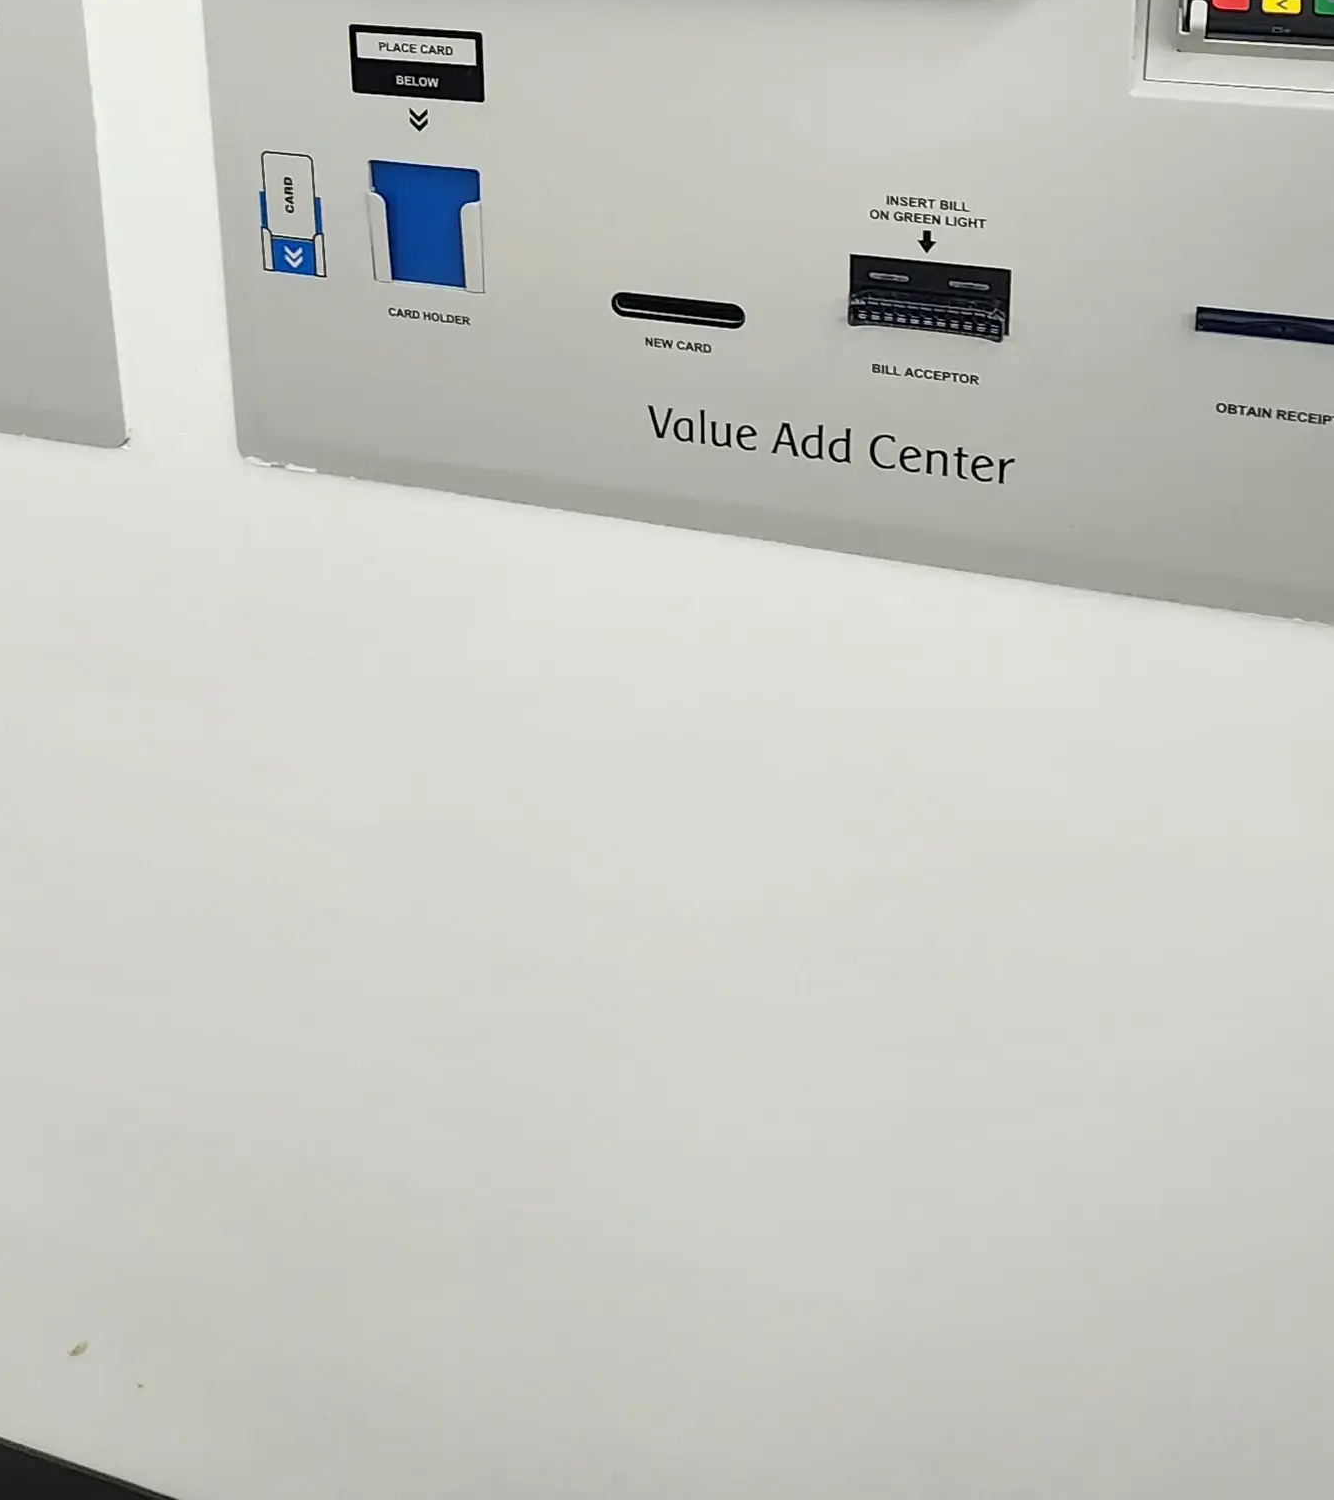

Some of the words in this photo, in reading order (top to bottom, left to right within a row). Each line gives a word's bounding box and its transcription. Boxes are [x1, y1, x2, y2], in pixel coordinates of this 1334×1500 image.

[378, 41, 417, 54] PLACE
[420, 44, 454, 56] CARD
[395, 75, 439, 88] BELOW
[284, 176, 295, 214] CARD
[885, 195, 936, 209] INSERT
[939, 198, 971, 213] BILL
[869, 209, 889, 221] ON
[893, 211, 941, 226] GREEN
[945, 216, 987, 230] LIGHT
[388, 307, 420, 320] CARD
[423, 311, 471, 326] HOLDER
[644, 336, 674, 350] NEW
[676, 340, 712, 354] CARD
[871, 363, 901, 377] BILL
[904, 367, 980, 386] ACCEPTOR
[1215, 402, 1272, 419] OBTAIN
[648, 404, 758, 452] Value
[771, 422, 852, 464] Add
[869, 433, 1016, 485] Center
